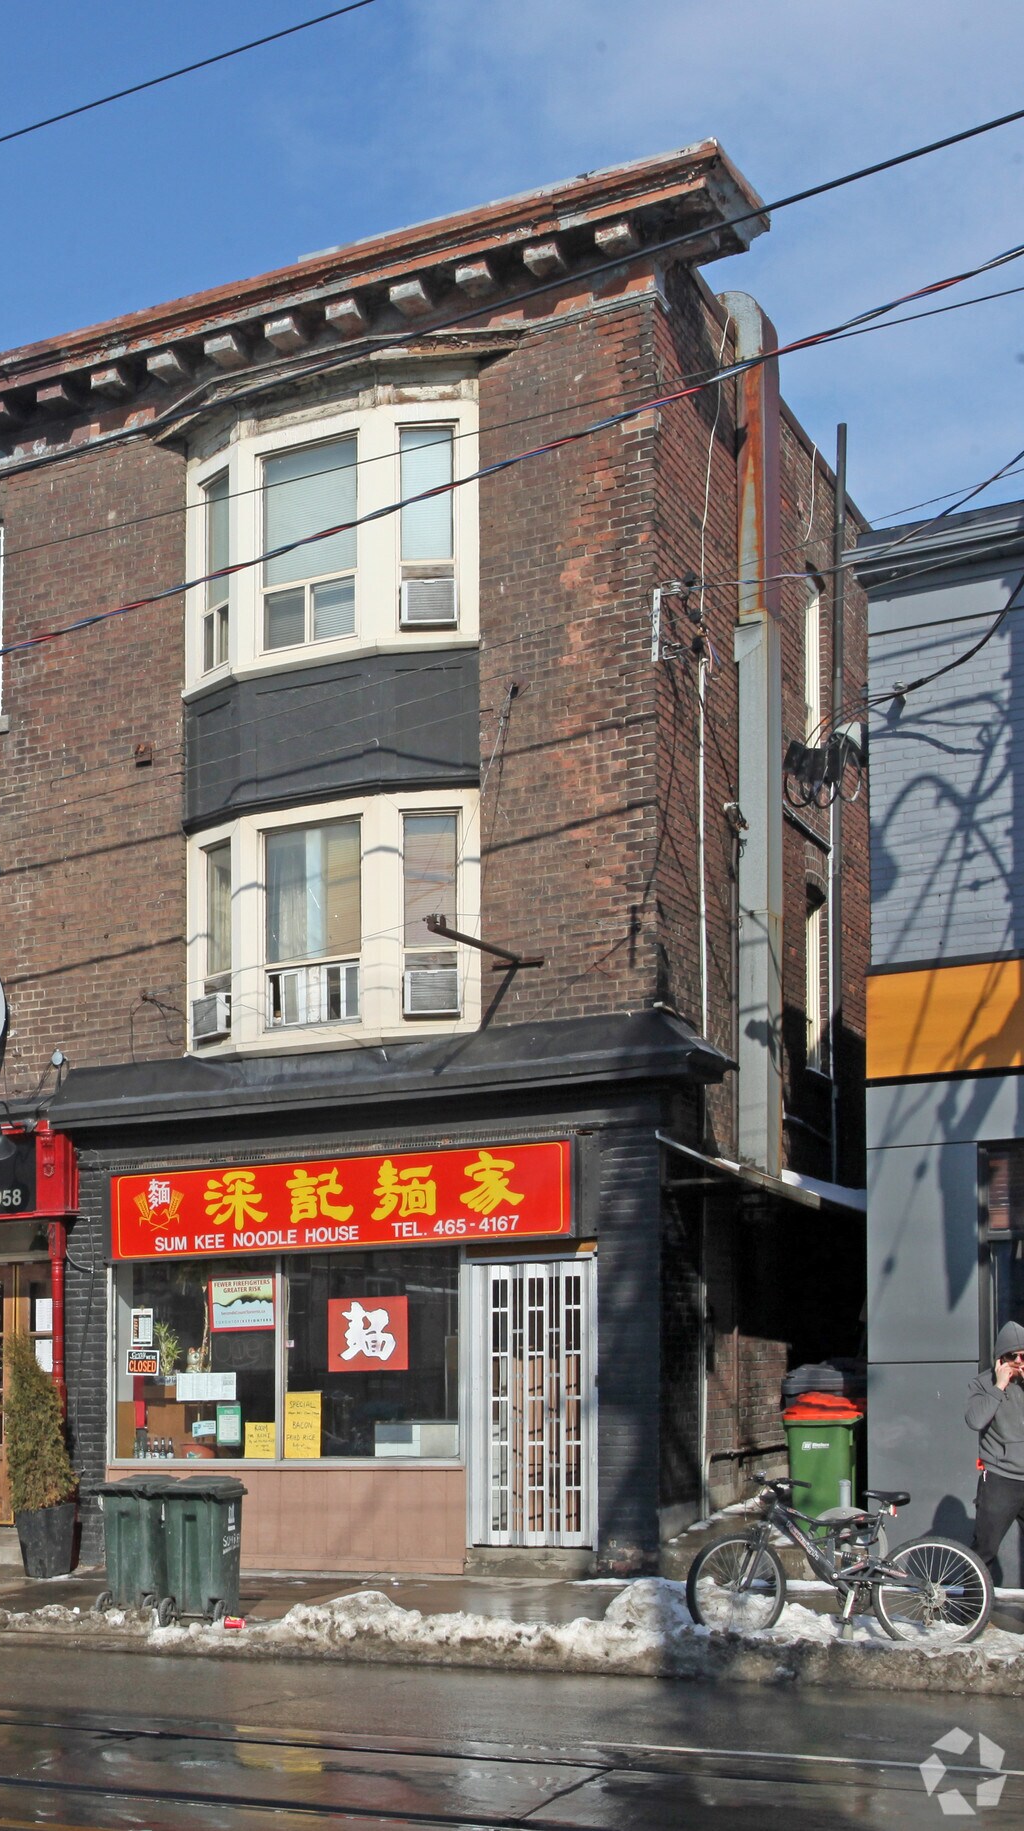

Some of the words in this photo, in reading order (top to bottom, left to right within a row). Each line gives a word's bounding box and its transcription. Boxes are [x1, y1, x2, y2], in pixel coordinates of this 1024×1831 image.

[155, 1236, 187, 1251] SUM
[194, 1234, 225, 1250] KEE
[233, 1230, 297, 1247] NOODLE
[305, 1225, 359, 1243] HOUSE
[391, 1221, 427, 1238] TEL.
[233, 1279, 270, 1287] FIREFIGHTERS
[129, 1360, 156, 1373] CLOSED
[289, 1400, 316, 1409] SPECIAL
